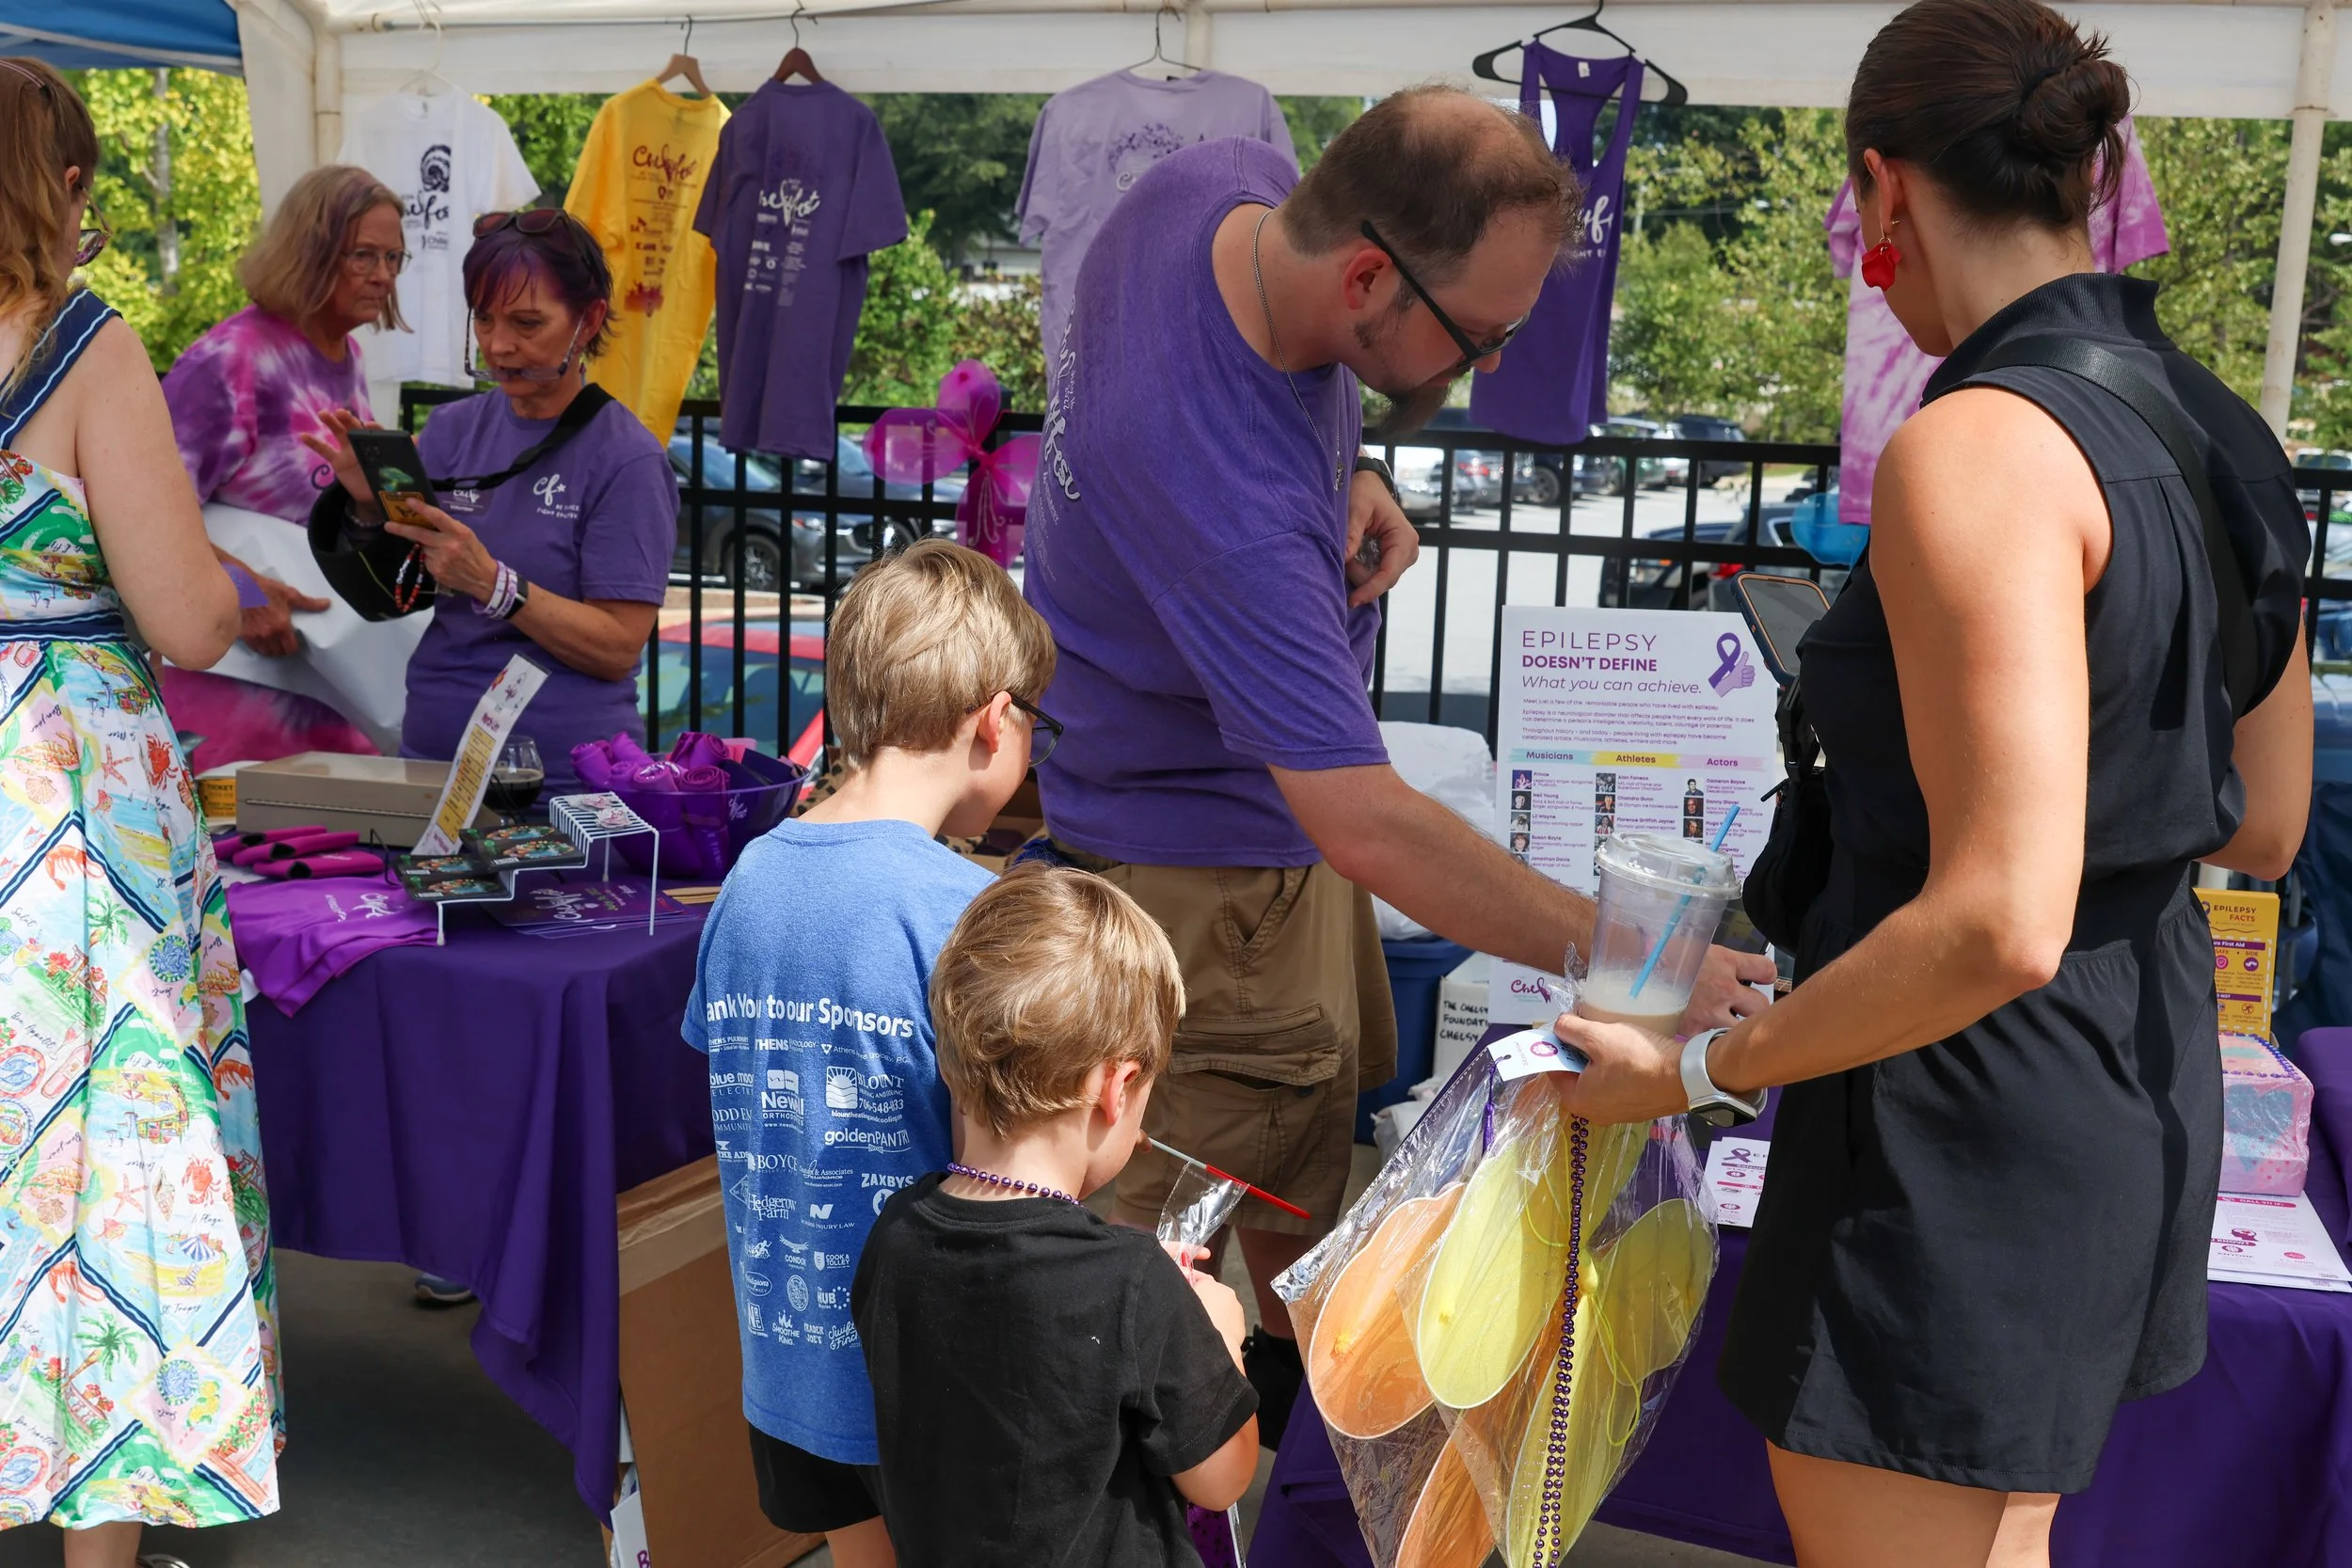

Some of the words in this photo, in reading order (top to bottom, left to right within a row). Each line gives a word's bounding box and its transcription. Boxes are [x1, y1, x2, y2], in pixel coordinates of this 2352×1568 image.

[1522, 630, 1658, 651] EPILEPSY
[1599, 657, 1658, 673] DEFINE
[1521, 675, 1566, 689] What
[1568, 679, 1598, 692] you
[1603, 682, 1633, 691] can
[1637, 679, 1702, 694] achieve.
[1526, 752, 1573, 760] Musicians
[1616, 754, 1656, 764] Athletes
[1707, 758, 1739, 767] Actors
[2214, 905, 2256, 914] EPILEPSY
[1443, 1000, 1456, 1010] THE
[707, 993, 737, 1022] ank
[767, 994, 786, 1020] to
[787, 1001, 814, 1022] our
[818, 998, 914, 1037] Sponsors
[1443, 1014, 1489, 1026] FOUNDATI
[755, 1038, 789, 1051] THENS
[834, 1046, 855, 1055] Athens
[709, 1072, 735, 1085] blue
[857, 1072, 903, 1089] BLOUNT
[712, 1108, 739, 1122] ODD
[861, 1173, 914, 1188] ZAXBYS
[757, 1208, 789, 1221] Farm
[818, 1291, 836, 1304] HUB
[771, 1323, 800, 1338] SMOOTHIE
[803, 1323, 824, 1335] TRADER
